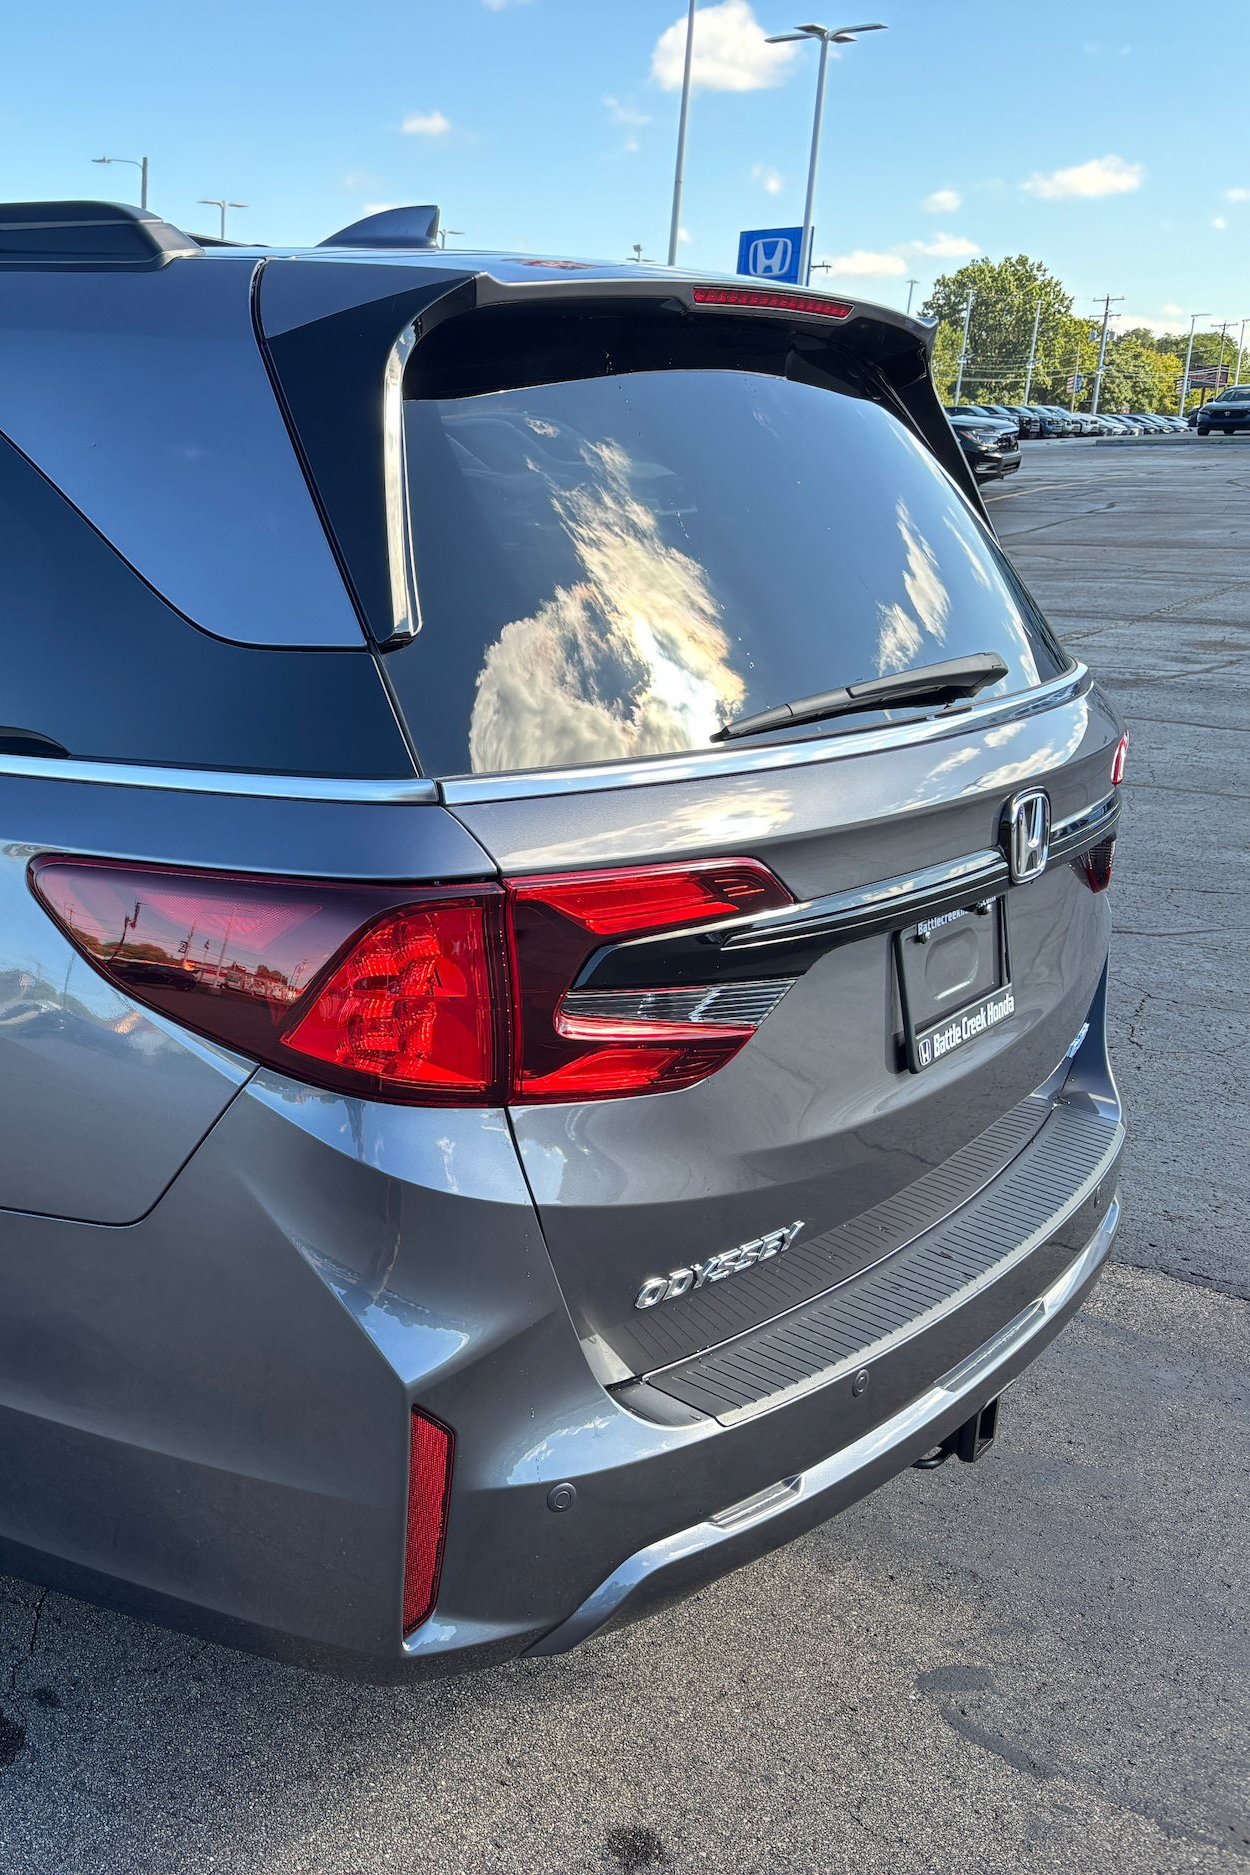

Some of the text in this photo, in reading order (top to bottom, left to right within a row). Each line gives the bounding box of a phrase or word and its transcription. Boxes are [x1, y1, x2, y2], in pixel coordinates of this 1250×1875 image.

[933, 993, 1015, 1058] Battle Creek Honda
[635, 1220, 805, 1309] ODYSSEY
